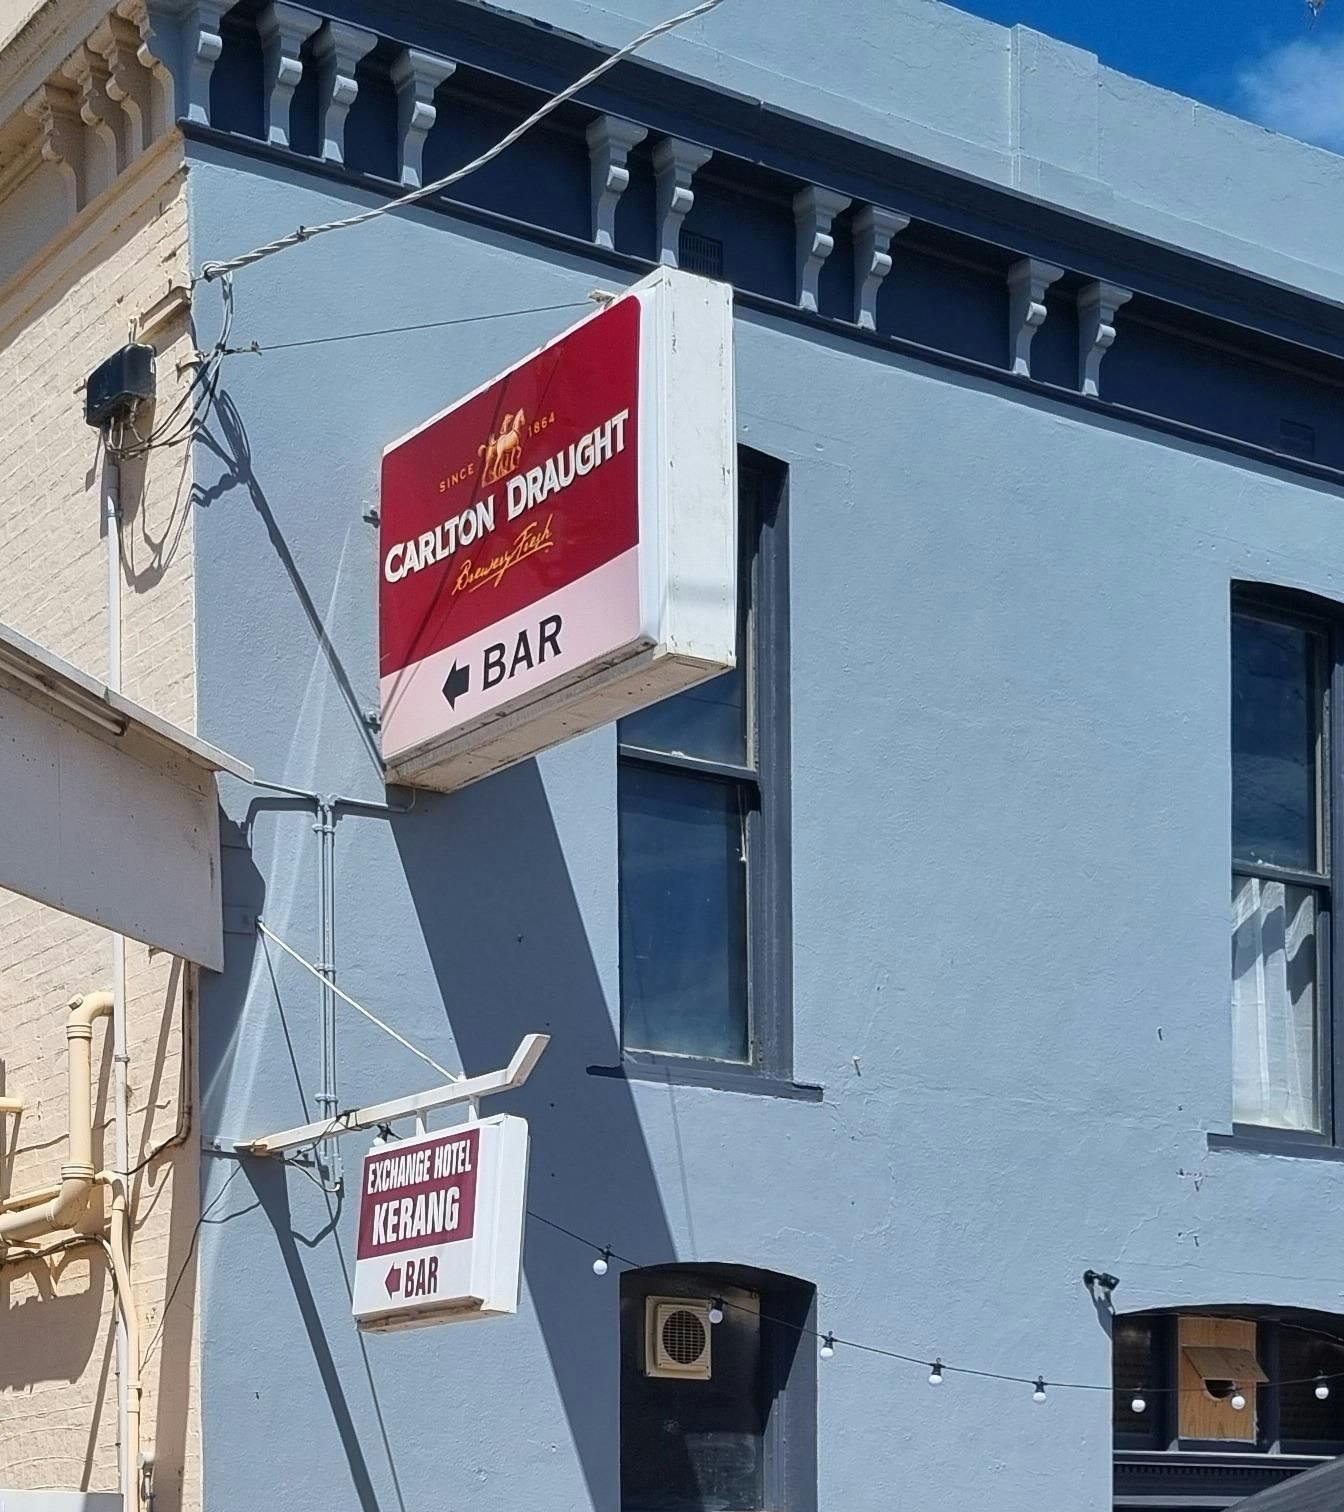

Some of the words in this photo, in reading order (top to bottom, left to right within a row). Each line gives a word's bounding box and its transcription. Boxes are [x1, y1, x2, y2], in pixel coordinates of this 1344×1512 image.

[439, 463, 474, 494] SINCE
[527, 411, 556, 440] 1864
[384, 494, 497, 585] CARLTON
[506, 408, 630, 520] DRAUGHT
[512, 512, 554, 561] Fresh
[480, 613, 564, 693] BAR
[367, 1149, 431, 1195] EXCHANGE
[434, 1139, 472, 1178] HOTEL
[372, 1186, 460, 1246] KERANG
[405, 1255, 439, 1298] BAR
